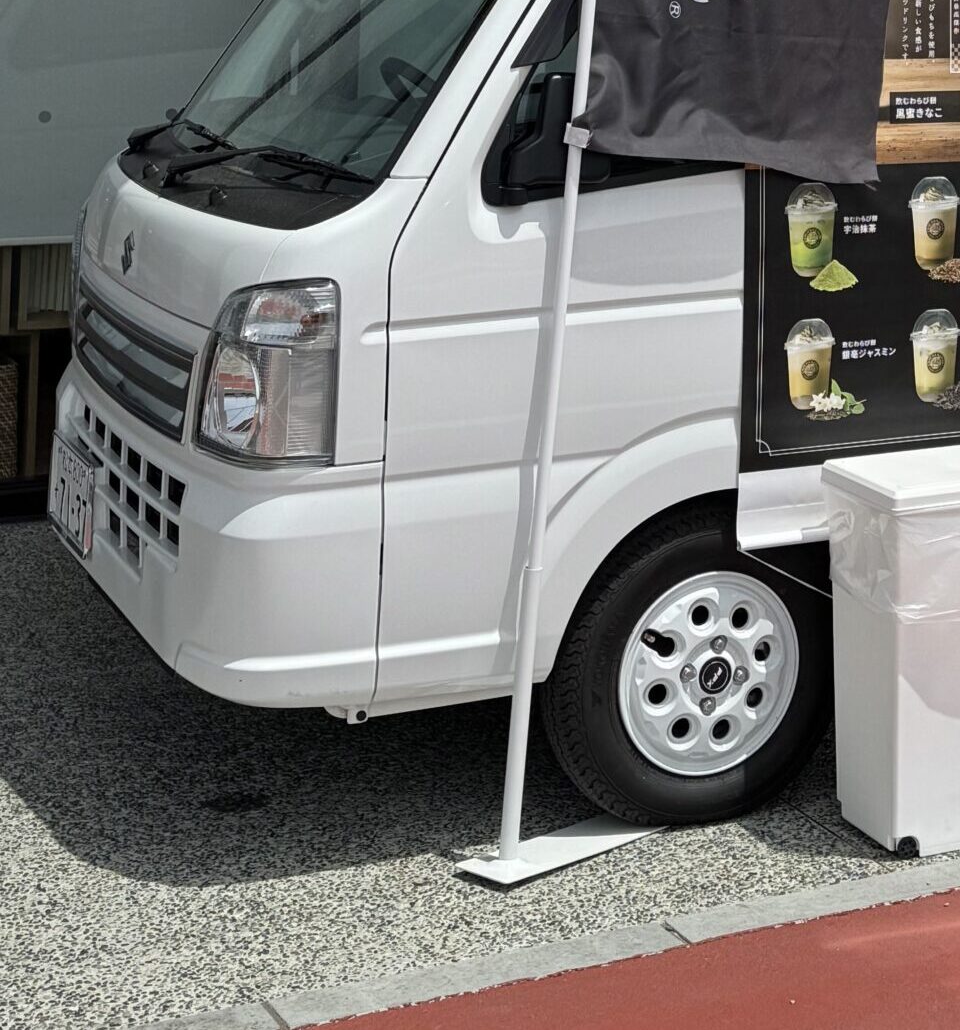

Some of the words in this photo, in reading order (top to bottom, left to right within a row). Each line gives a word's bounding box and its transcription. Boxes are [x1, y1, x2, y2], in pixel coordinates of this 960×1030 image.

[843, 224, 877, 235] 宇治抹茶
[60, 476, 87, 544] 71-37
